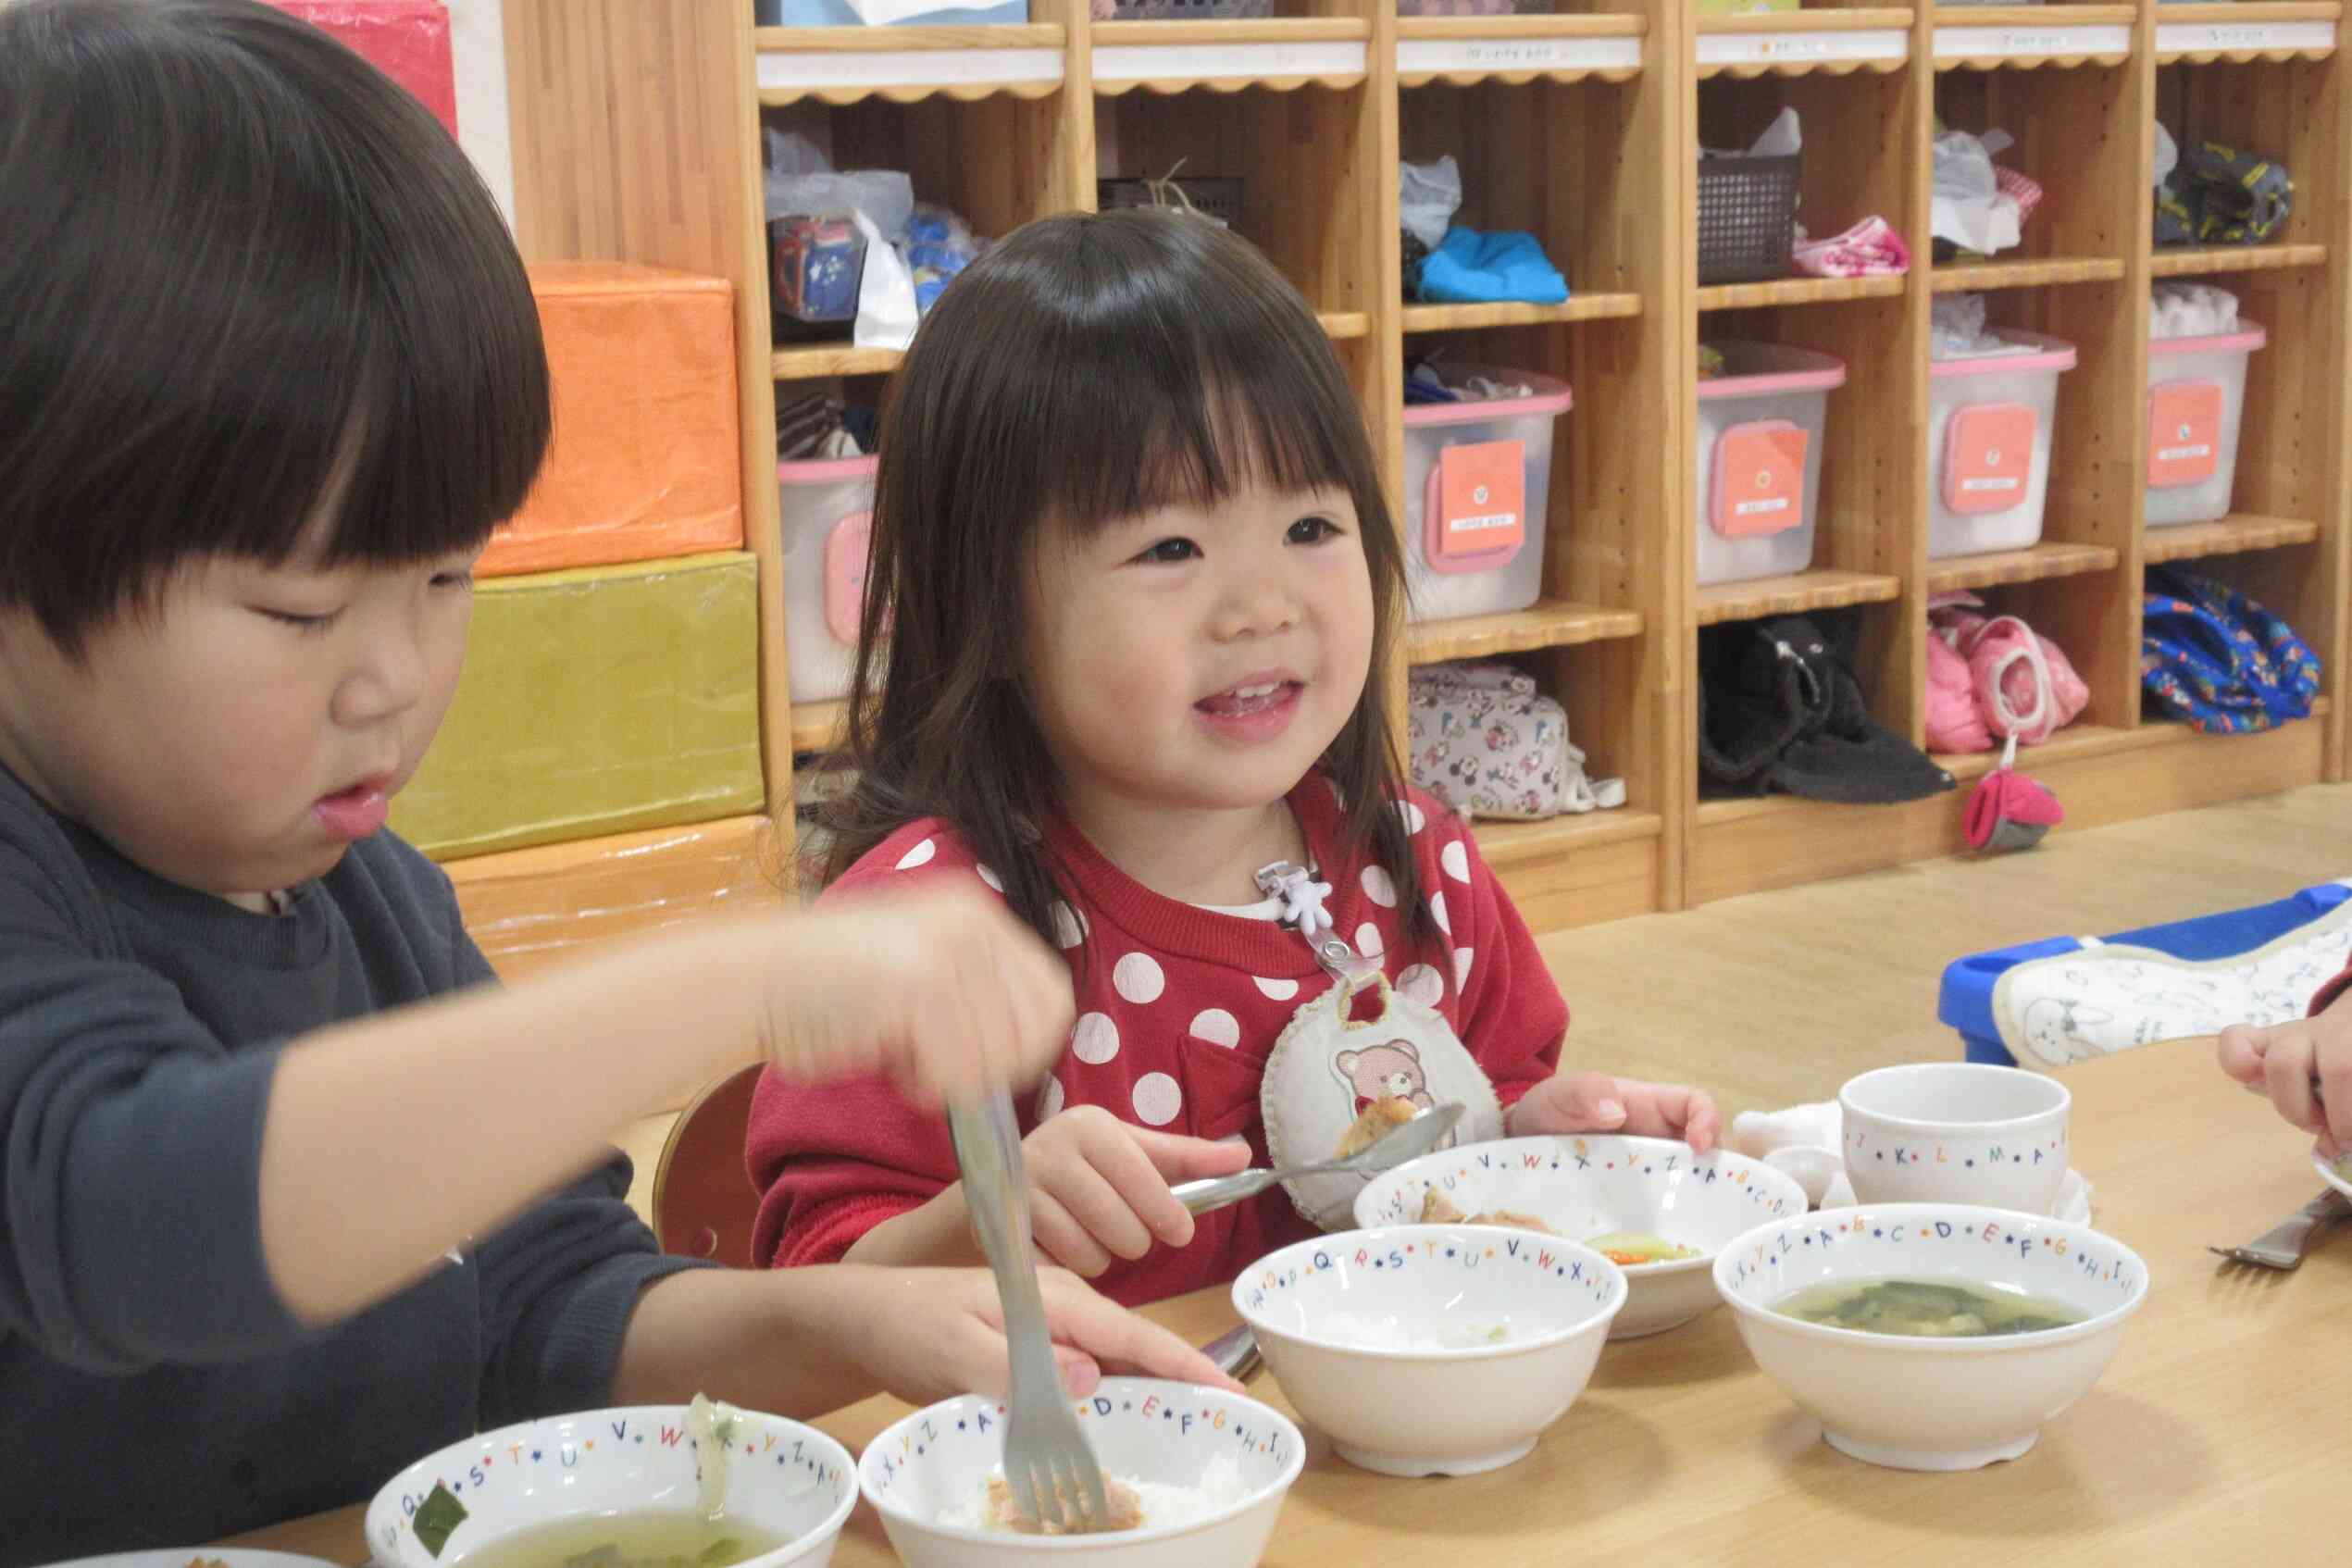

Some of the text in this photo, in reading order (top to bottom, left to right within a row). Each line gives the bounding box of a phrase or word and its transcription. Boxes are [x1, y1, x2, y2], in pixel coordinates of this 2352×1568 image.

[1478, 1153, 1490, 1168] V
[1524, 1153, 1541, 1169] W
[1575, 1154, 1590, 1169] X
[1705, 1167, 1716, 1184] A
[1895, 1148, 1908, 1165] K
[1936, 1140, 1948, 1163] L
[1989, 1146, 2005, 1163] M
[1313, 1251, 1332, 1270] Q
[1354, 1248, 1368, 1267] R
[1389, 1251, 1403, 1268] S
[1424, 1241, 1437, 1259] T
[1464, 1252, 1478, 1267] U
[1507, 1238, 1519, 1256] V
[1538, 1248, 1555, 1269] W
[1571, 1261, 1582, 1281] X
[1777, 1233, 1791, 1253] Z
[1820, 1229, 1833, 1248] A
[1891, 1226, 1904, 1241] C
[1935, 1222, 1951, 1238] D
[1982, 1223, 1999, 1243] E
[2021, 1239, 2032, 1258] F
[2055, 1238, 2067, 1254] G
[2085, 1259, 2098, 1276] H
[2113, 1261, 2122, 1278] I
[922, 1420, 938, 1442] Z
[977, 1412, 991, 1434] A
[1094, 1397, 1112, 1416] D
[1141, 1395, 1160, 1419] E
[1181, 1413, 1192, 1436] F
[1243, 1429, 1257, 1451] H
[403, 1494, 415, 1516] Q
[469, 1466, 484, 1487] S
[508, 1444, 521, 1465] T
[561, 1449, 577, 1467] U
[612, 1420, 626, 1440] V
[660, 1425, 683, 1448] W
[765, 1433, 777, 1451] Y
[793, 1440, 804, 1462] Z
